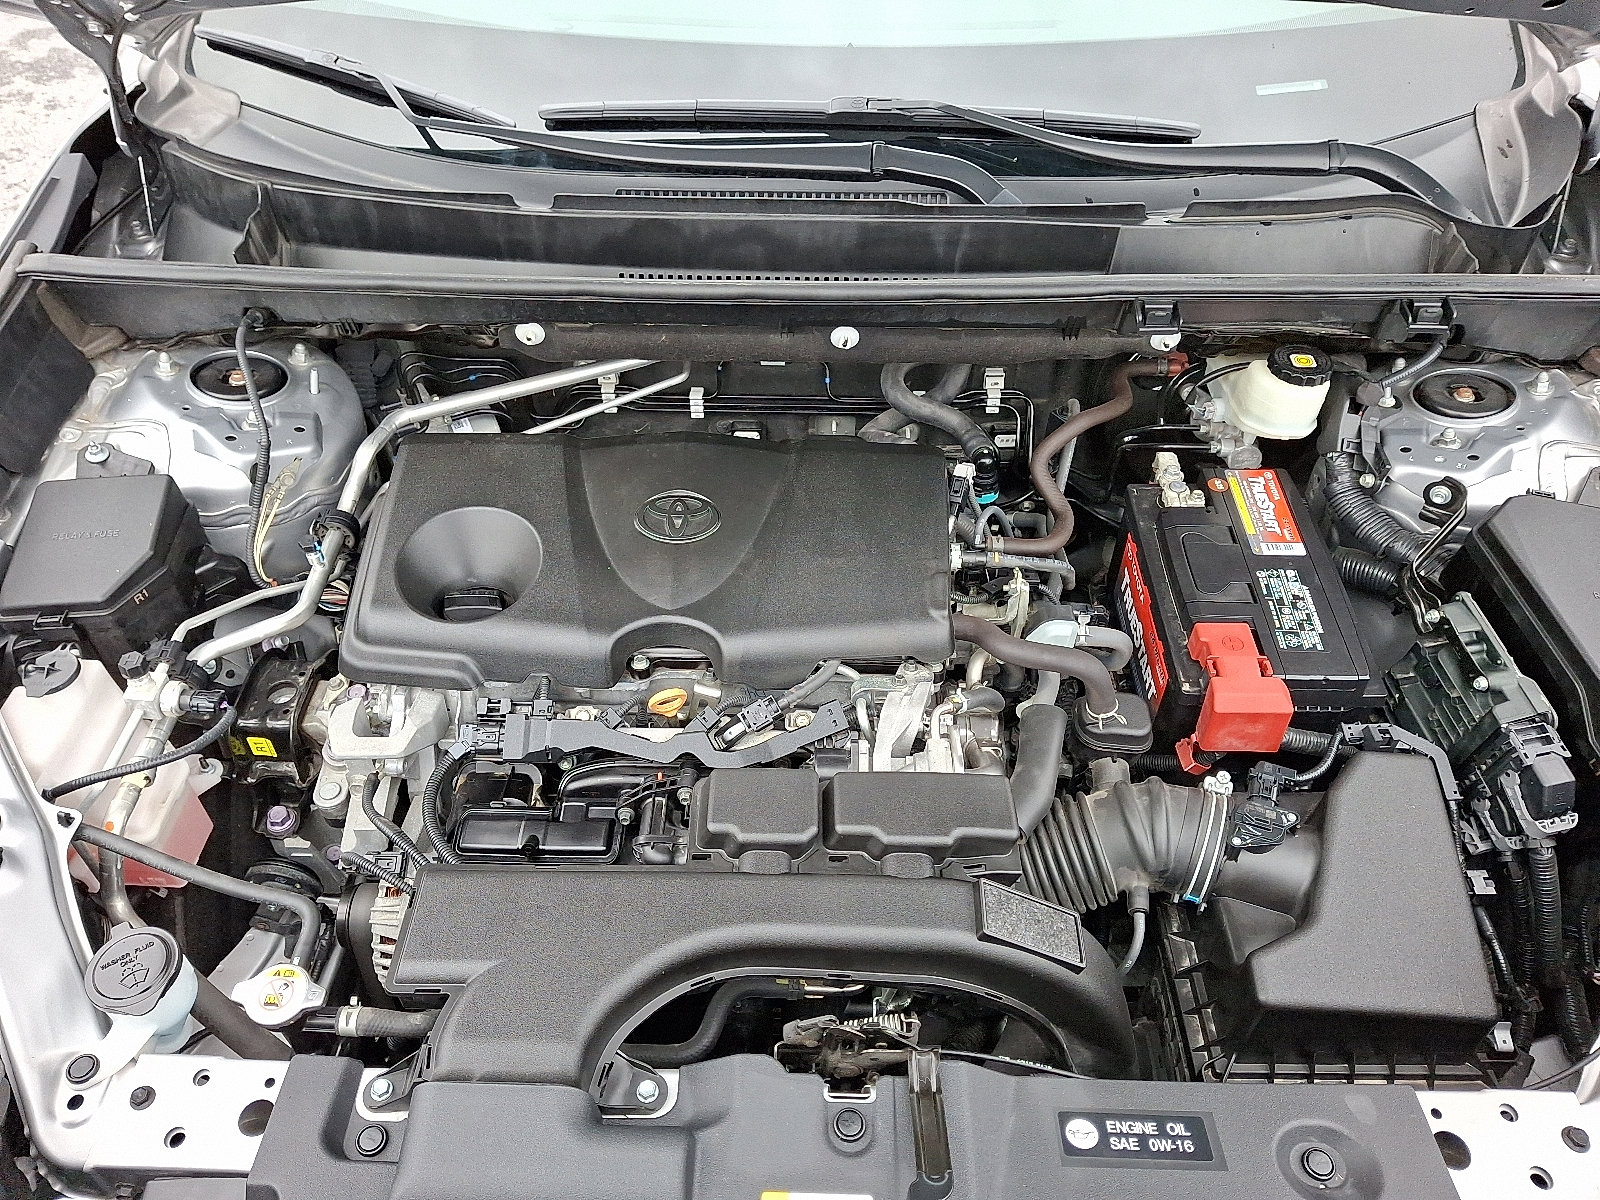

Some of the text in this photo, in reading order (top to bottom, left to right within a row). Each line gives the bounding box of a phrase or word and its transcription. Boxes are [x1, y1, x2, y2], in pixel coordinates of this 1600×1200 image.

[1267, 479, 1281, 501] TOYOTA
[52, 531, 84, 541] RELAY
[94, 529, 121, 538] FUSE
[1131, 558, 1145, 604] TOYOTA
[133, 589, 149, 605] R1
[253, 742, 268, 753] R1
[100, 941, 155, 970] WASHER FLUID
[120, 954, 138, 968] ONLY
[1105, 1120, 1192, 1136] ENGINE OIL
[1110, 1137, 1195, 1153] SAE 0W-16
